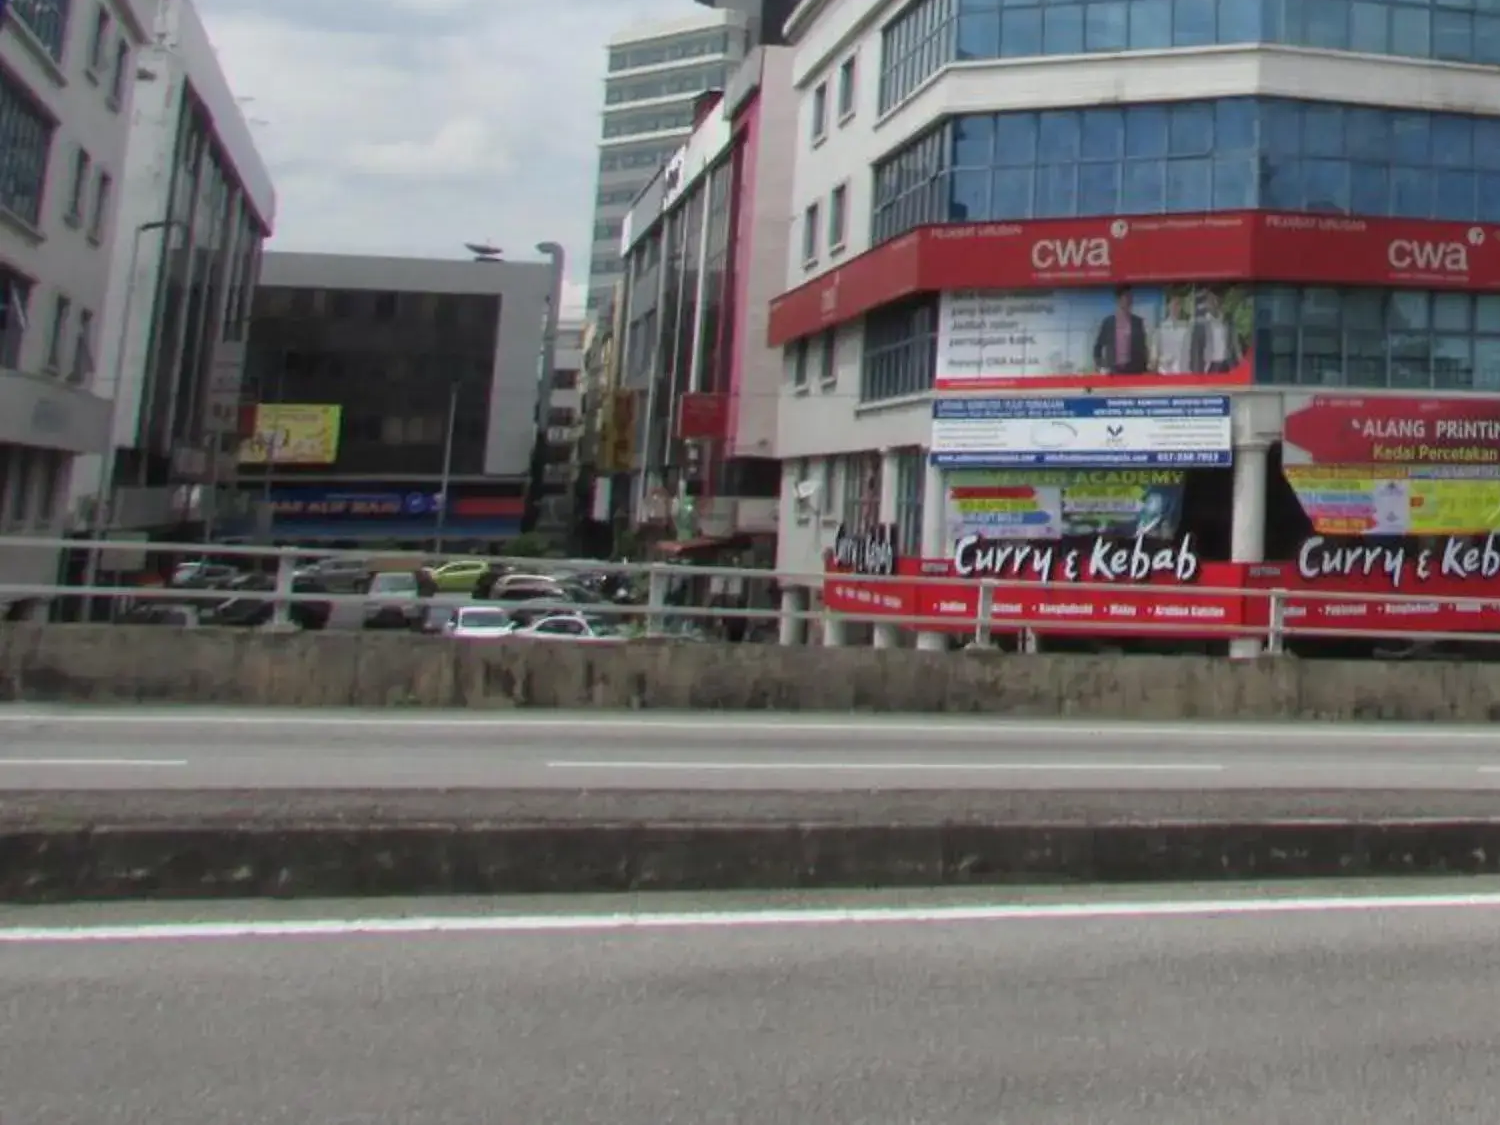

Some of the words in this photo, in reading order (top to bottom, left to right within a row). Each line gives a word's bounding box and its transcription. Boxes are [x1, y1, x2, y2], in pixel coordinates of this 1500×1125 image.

[1031, 237, 1111, 268] cwa
[1388, 239, 1469, 270] cwa
[1362, 418, 1426, 439] ALANG
[1373, 444, 1415, 460] Kedai
[1419, 444, 1499, 461] Percetakan
[1072, 470, 1185, 485] ACADEMY
[954, 534, 1054, 583] Curry
[1090, 528, 1198, 580] Kebab
[1299, 535, 1405, 587] Curry
